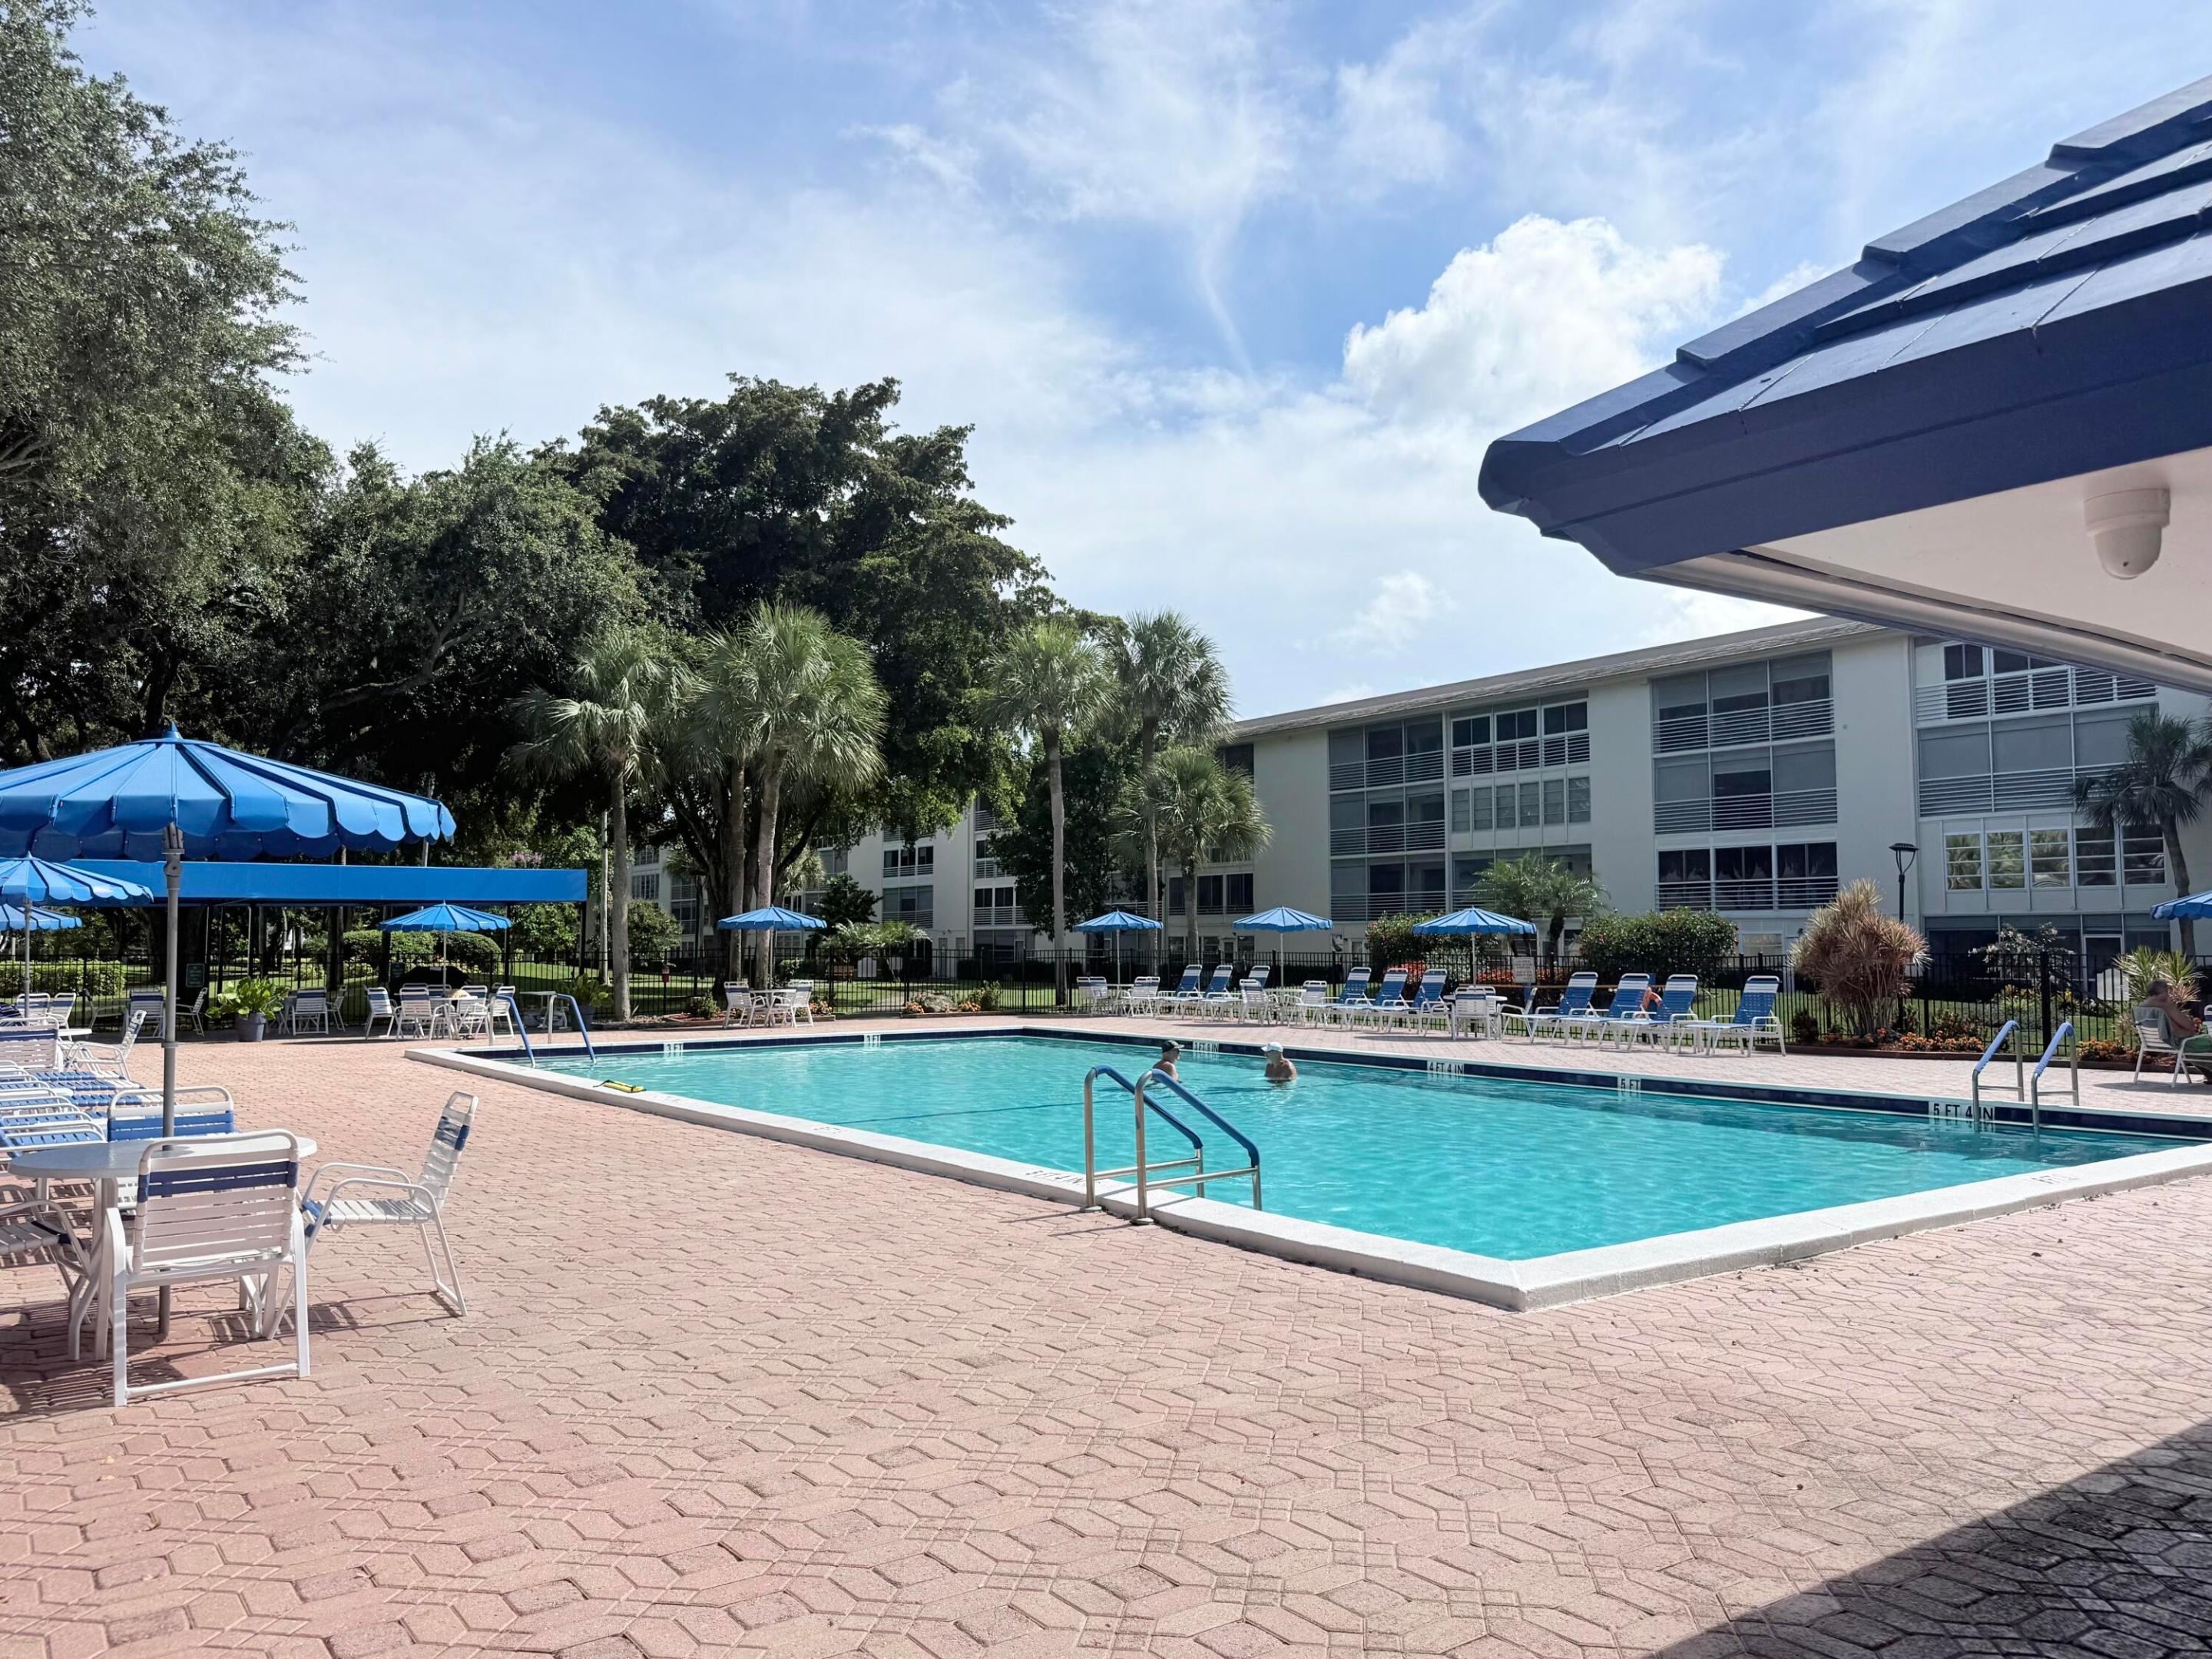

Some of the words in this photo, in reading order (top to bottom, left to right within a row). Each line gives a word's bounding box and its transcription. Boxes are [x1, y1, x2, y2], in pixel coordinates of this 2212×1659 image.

[1429, 1061, 1434, 1071] 4
[1436, 1062, 1445, 1072] FT
[1447, 1063, 1452, 1073] 4
[1455, 1064, 1463, 1075] IN
[1621, 1078, 1626, 1089] 5
[1629, 1079, 1640, 1090] FT
[1933, 1103, 1940, 1116] 5
[1945, 1104, 1961, 1118] FT
[1965, 1106, 1973, 1118] 4
[1979, 1106, 1993, 1121] IN
